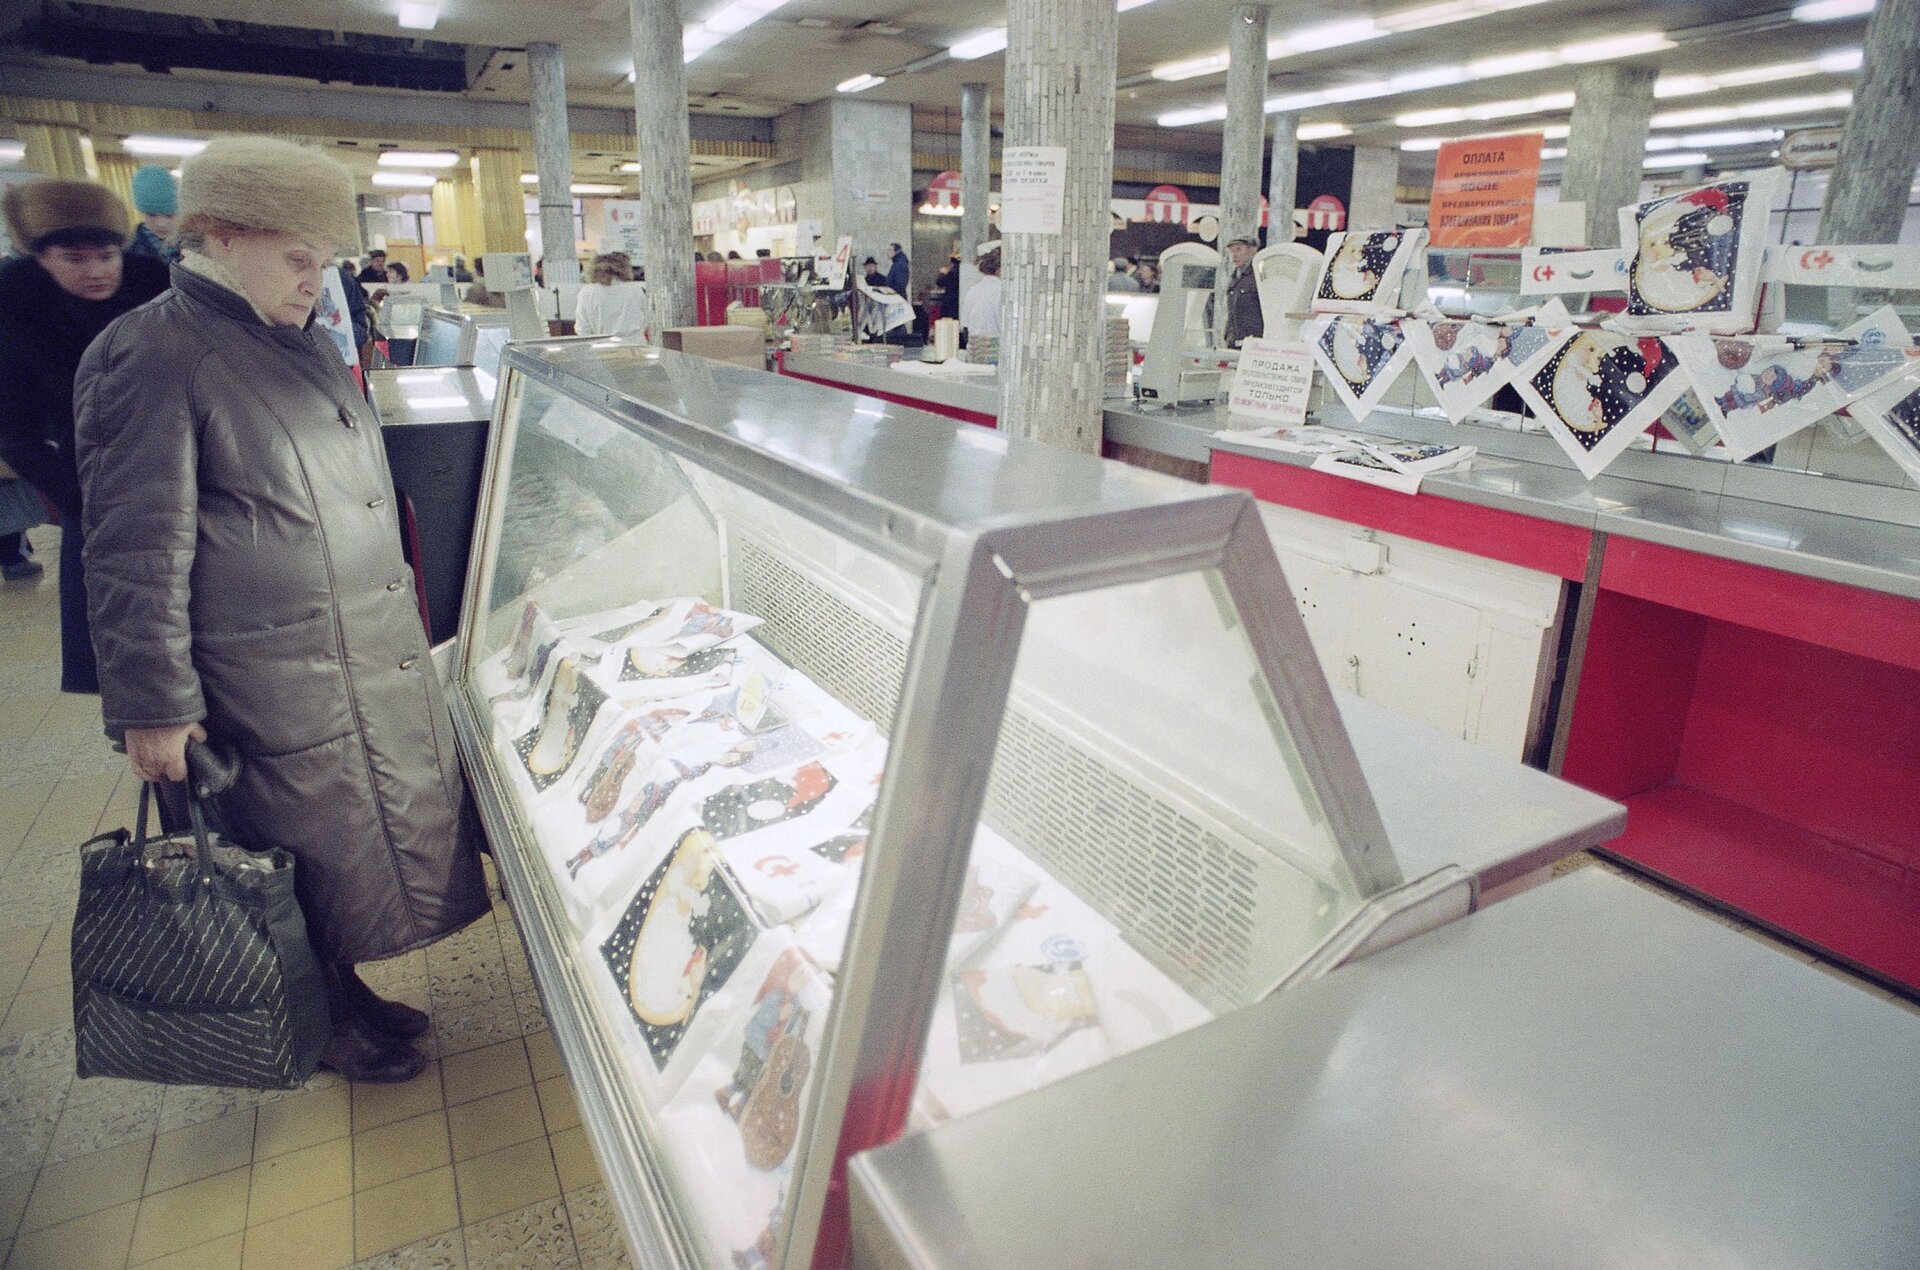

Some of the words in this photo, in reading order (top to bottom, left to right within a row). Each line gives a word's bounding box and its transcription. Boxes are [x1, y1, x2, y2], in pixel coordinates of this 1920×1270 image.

[1463, 151, 1505, 165] ОПЛАТА
[1460, 182, 1499, 194] ПОСЛЕ
[836, 244, 848, 270] 4
[1252, 359, 1300, 372] ПРОДАЖА
[1249, 389, 1289, 403] ТОЛЬКО
